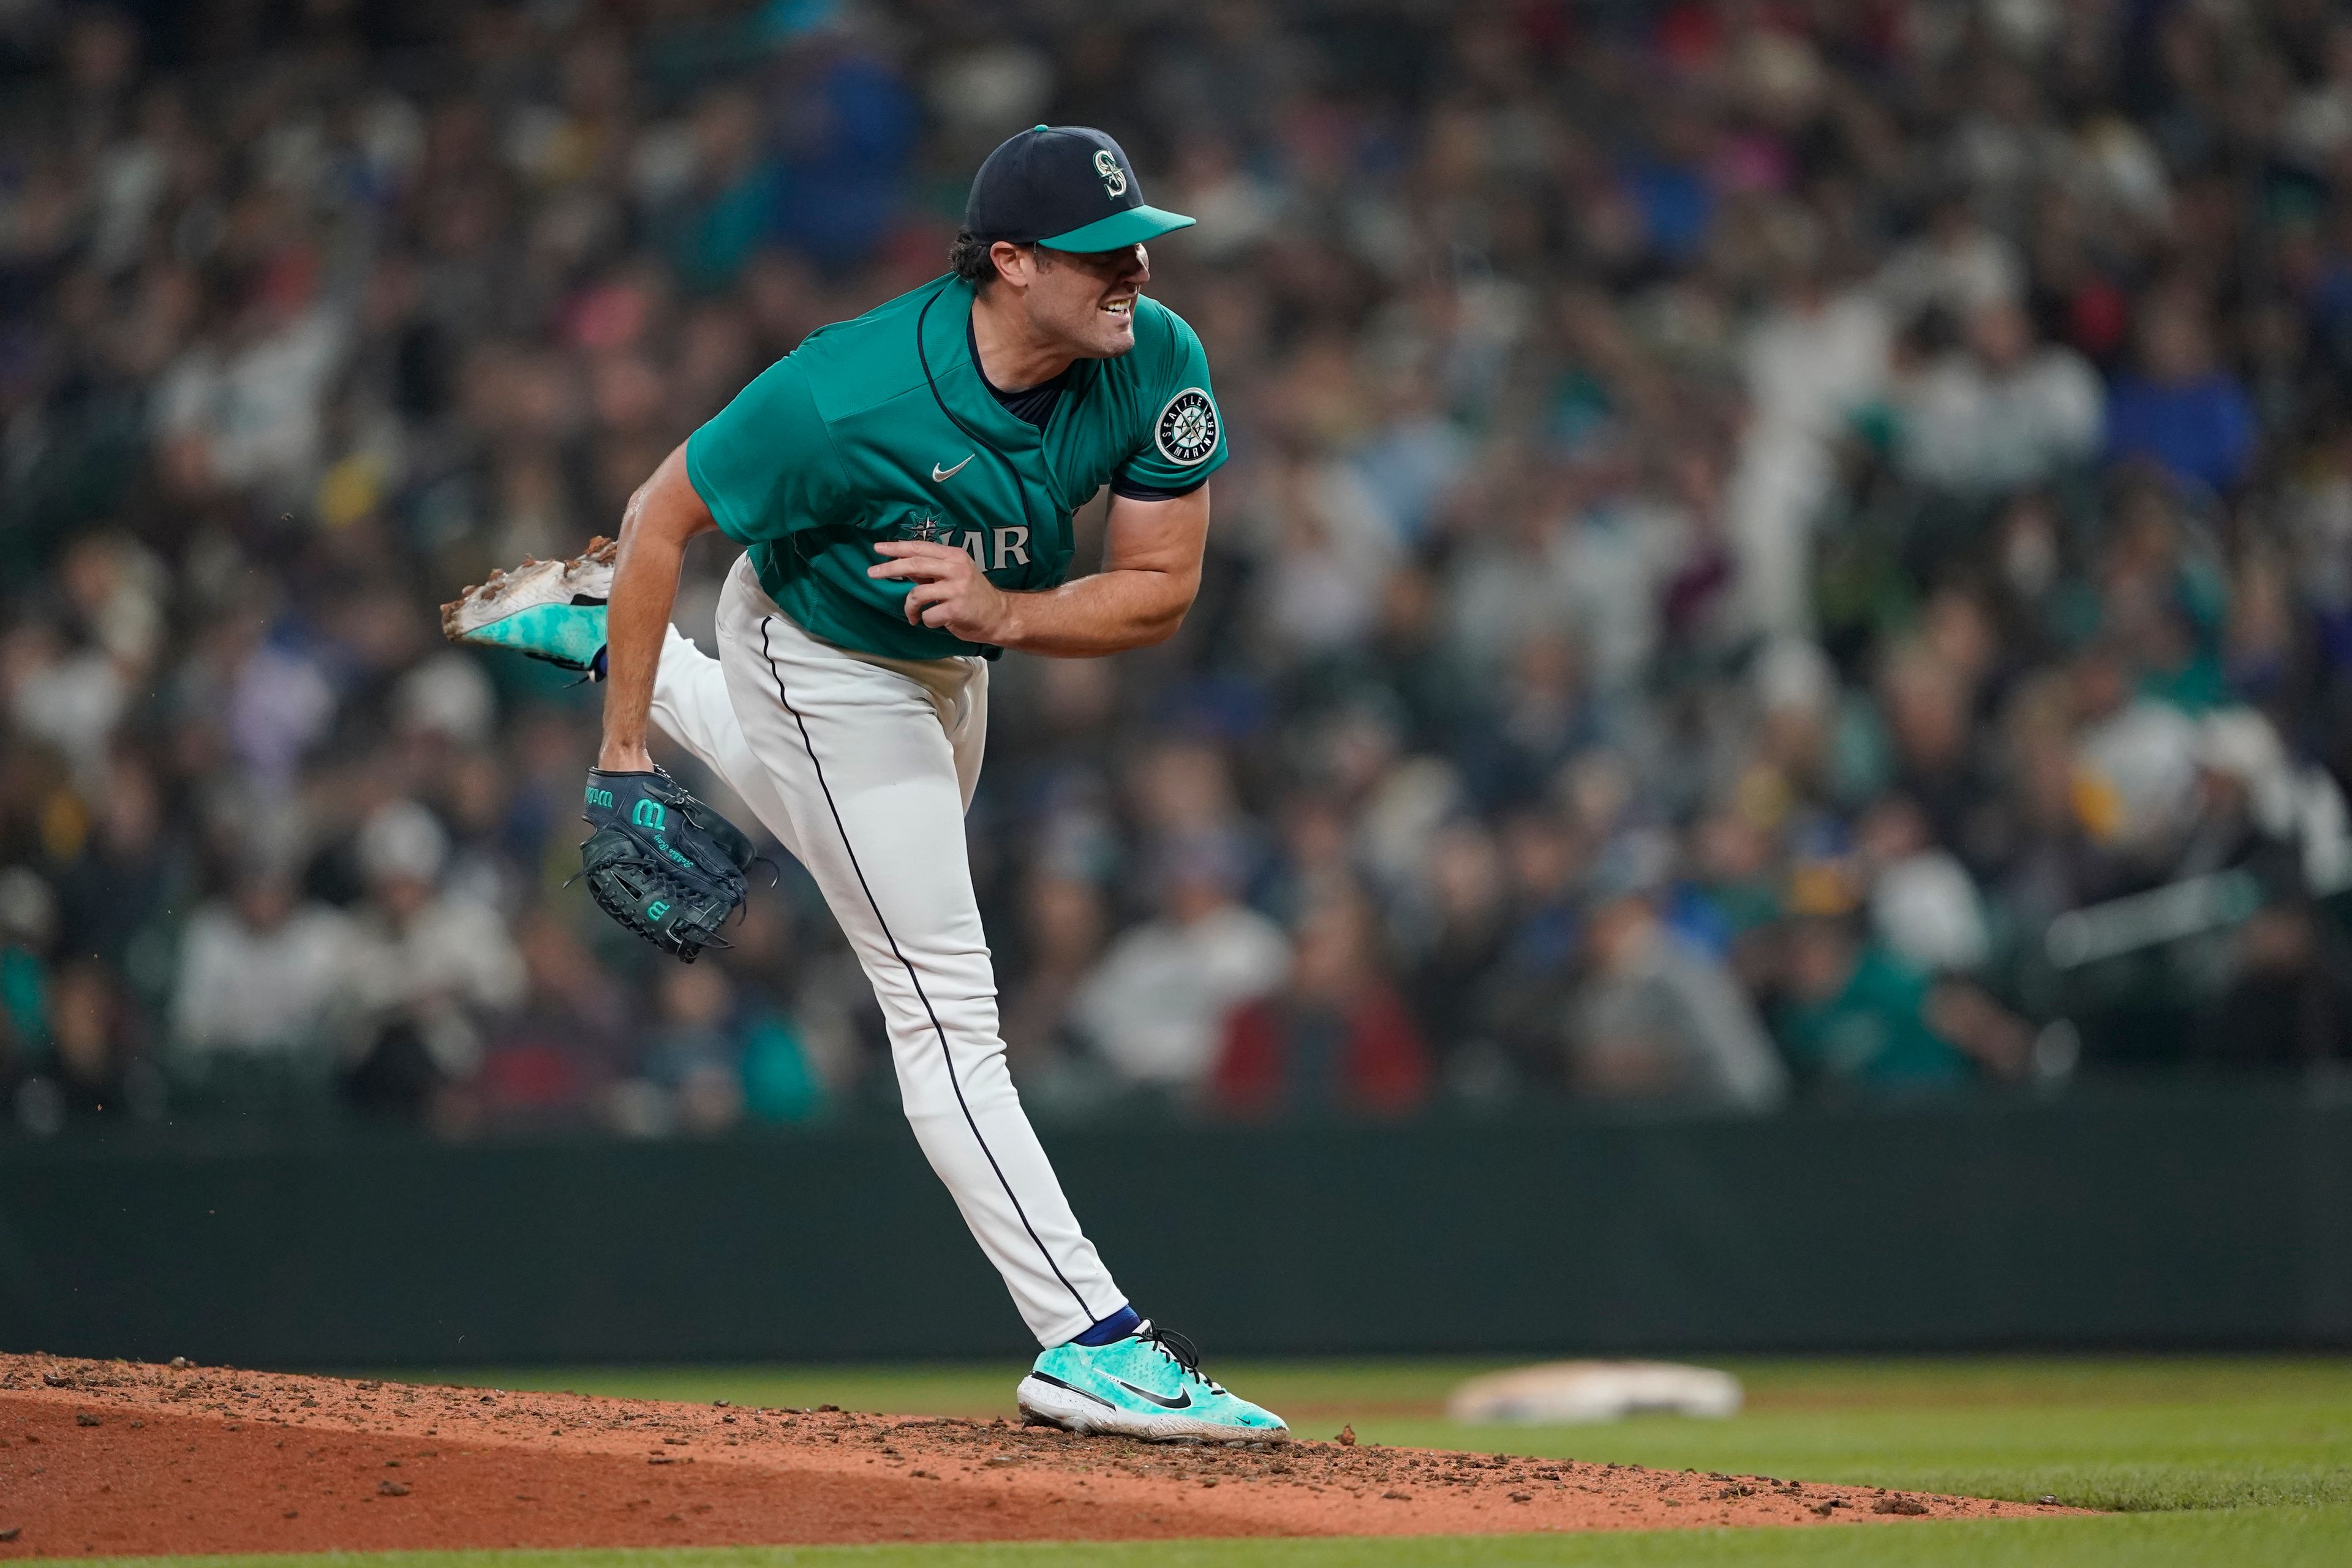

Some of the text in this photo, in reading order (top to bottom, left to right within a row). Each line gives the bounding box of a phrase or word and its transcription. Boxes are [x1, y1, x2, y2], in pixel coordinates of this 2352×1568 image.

[1093, 150, 1126, 200] S
[1163, 396, 1202, 437] SEATTLE
[1174, 412, 1214, 458] MARINERS
[632, 799, 666, 831] W
[654, 834, 693, 868] Robbie Ray
